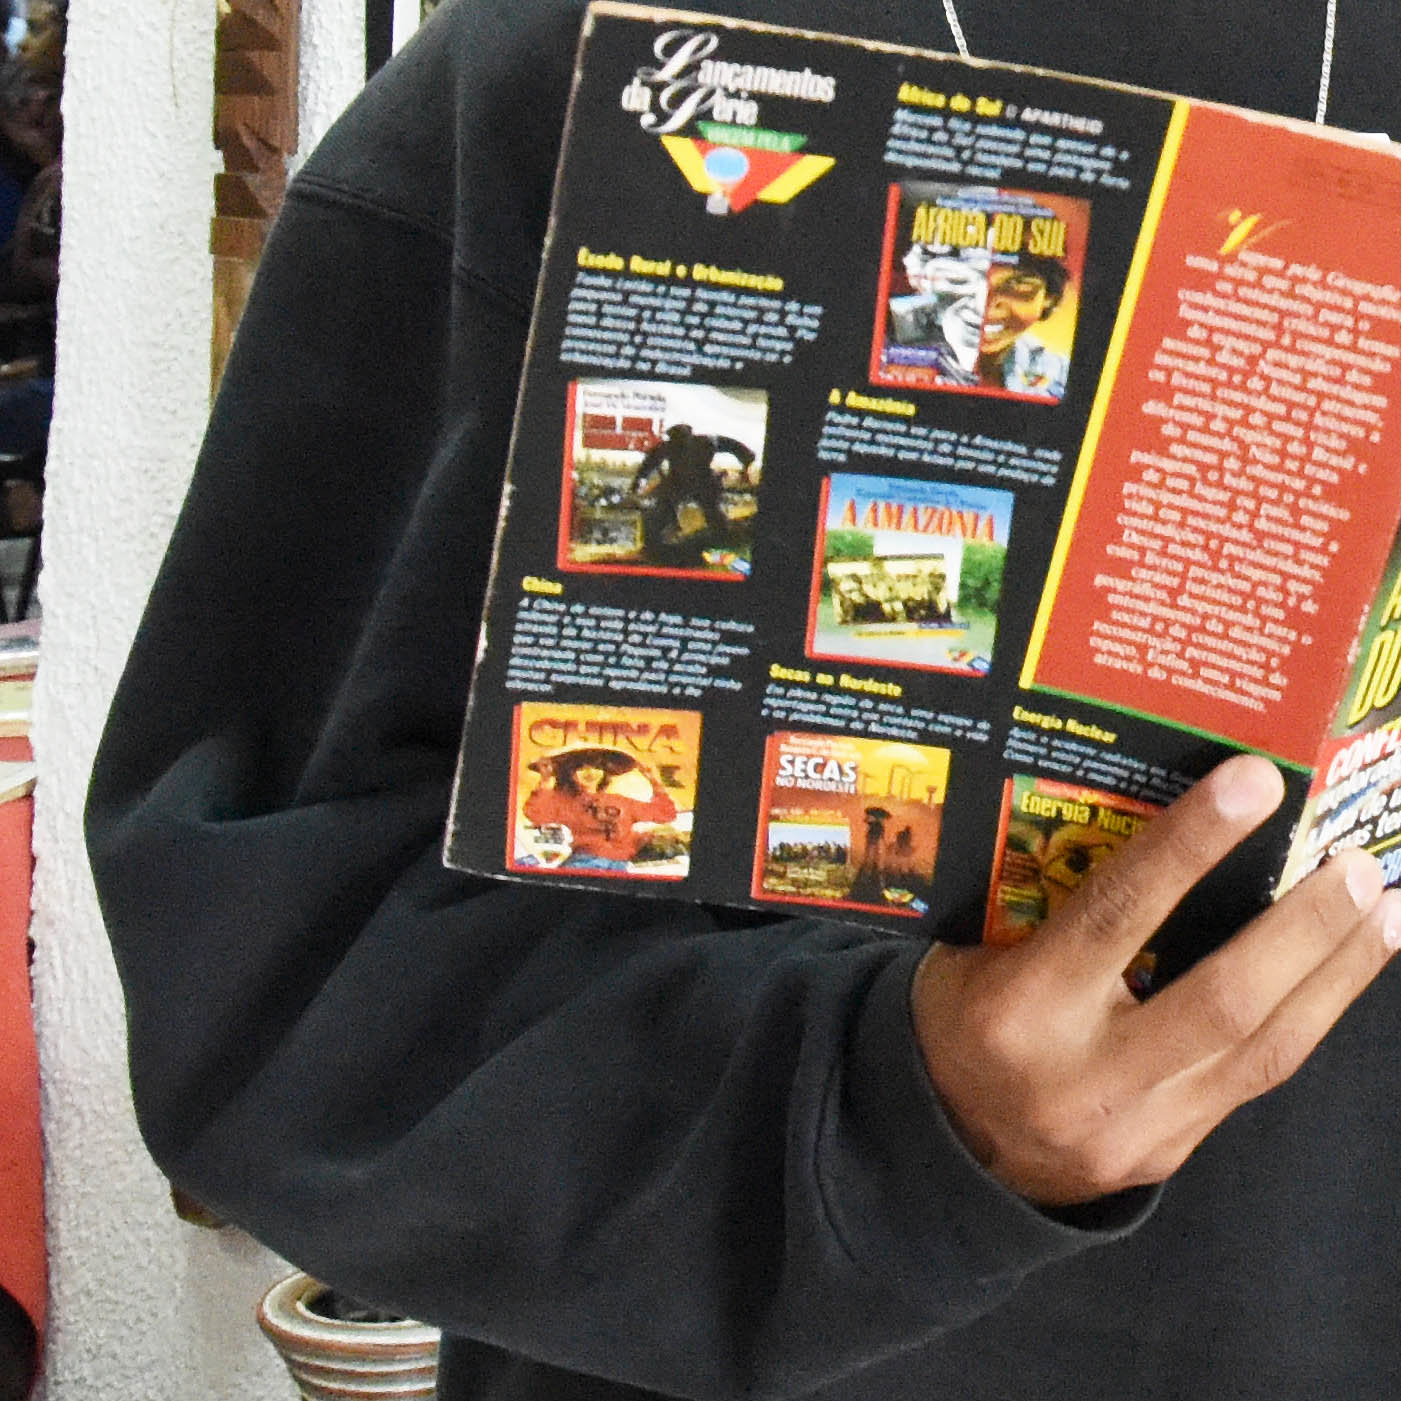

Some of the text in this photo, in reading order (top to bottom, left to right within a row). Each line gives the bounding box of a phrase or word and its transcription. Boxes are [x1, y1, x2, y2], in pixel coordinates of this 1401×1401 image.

[636, 29, 837, 104] Lançamentos
[991, 210, 1025, 255] DO
[1028, 215, 1067, 259] SUL
[629, 253, 672, 278] Rural
[521, 575, 565, 596] China
[838, 673, 903, 698] Nordeste
[529, 717, 683, 754] CHINA
[1012, 705, 1064, 731] Energia
[1065, 717, 1119, 744] Nuclear
[778, 753, 857, 783] SECAS
[1019, 790, 1091, 825] Energia
